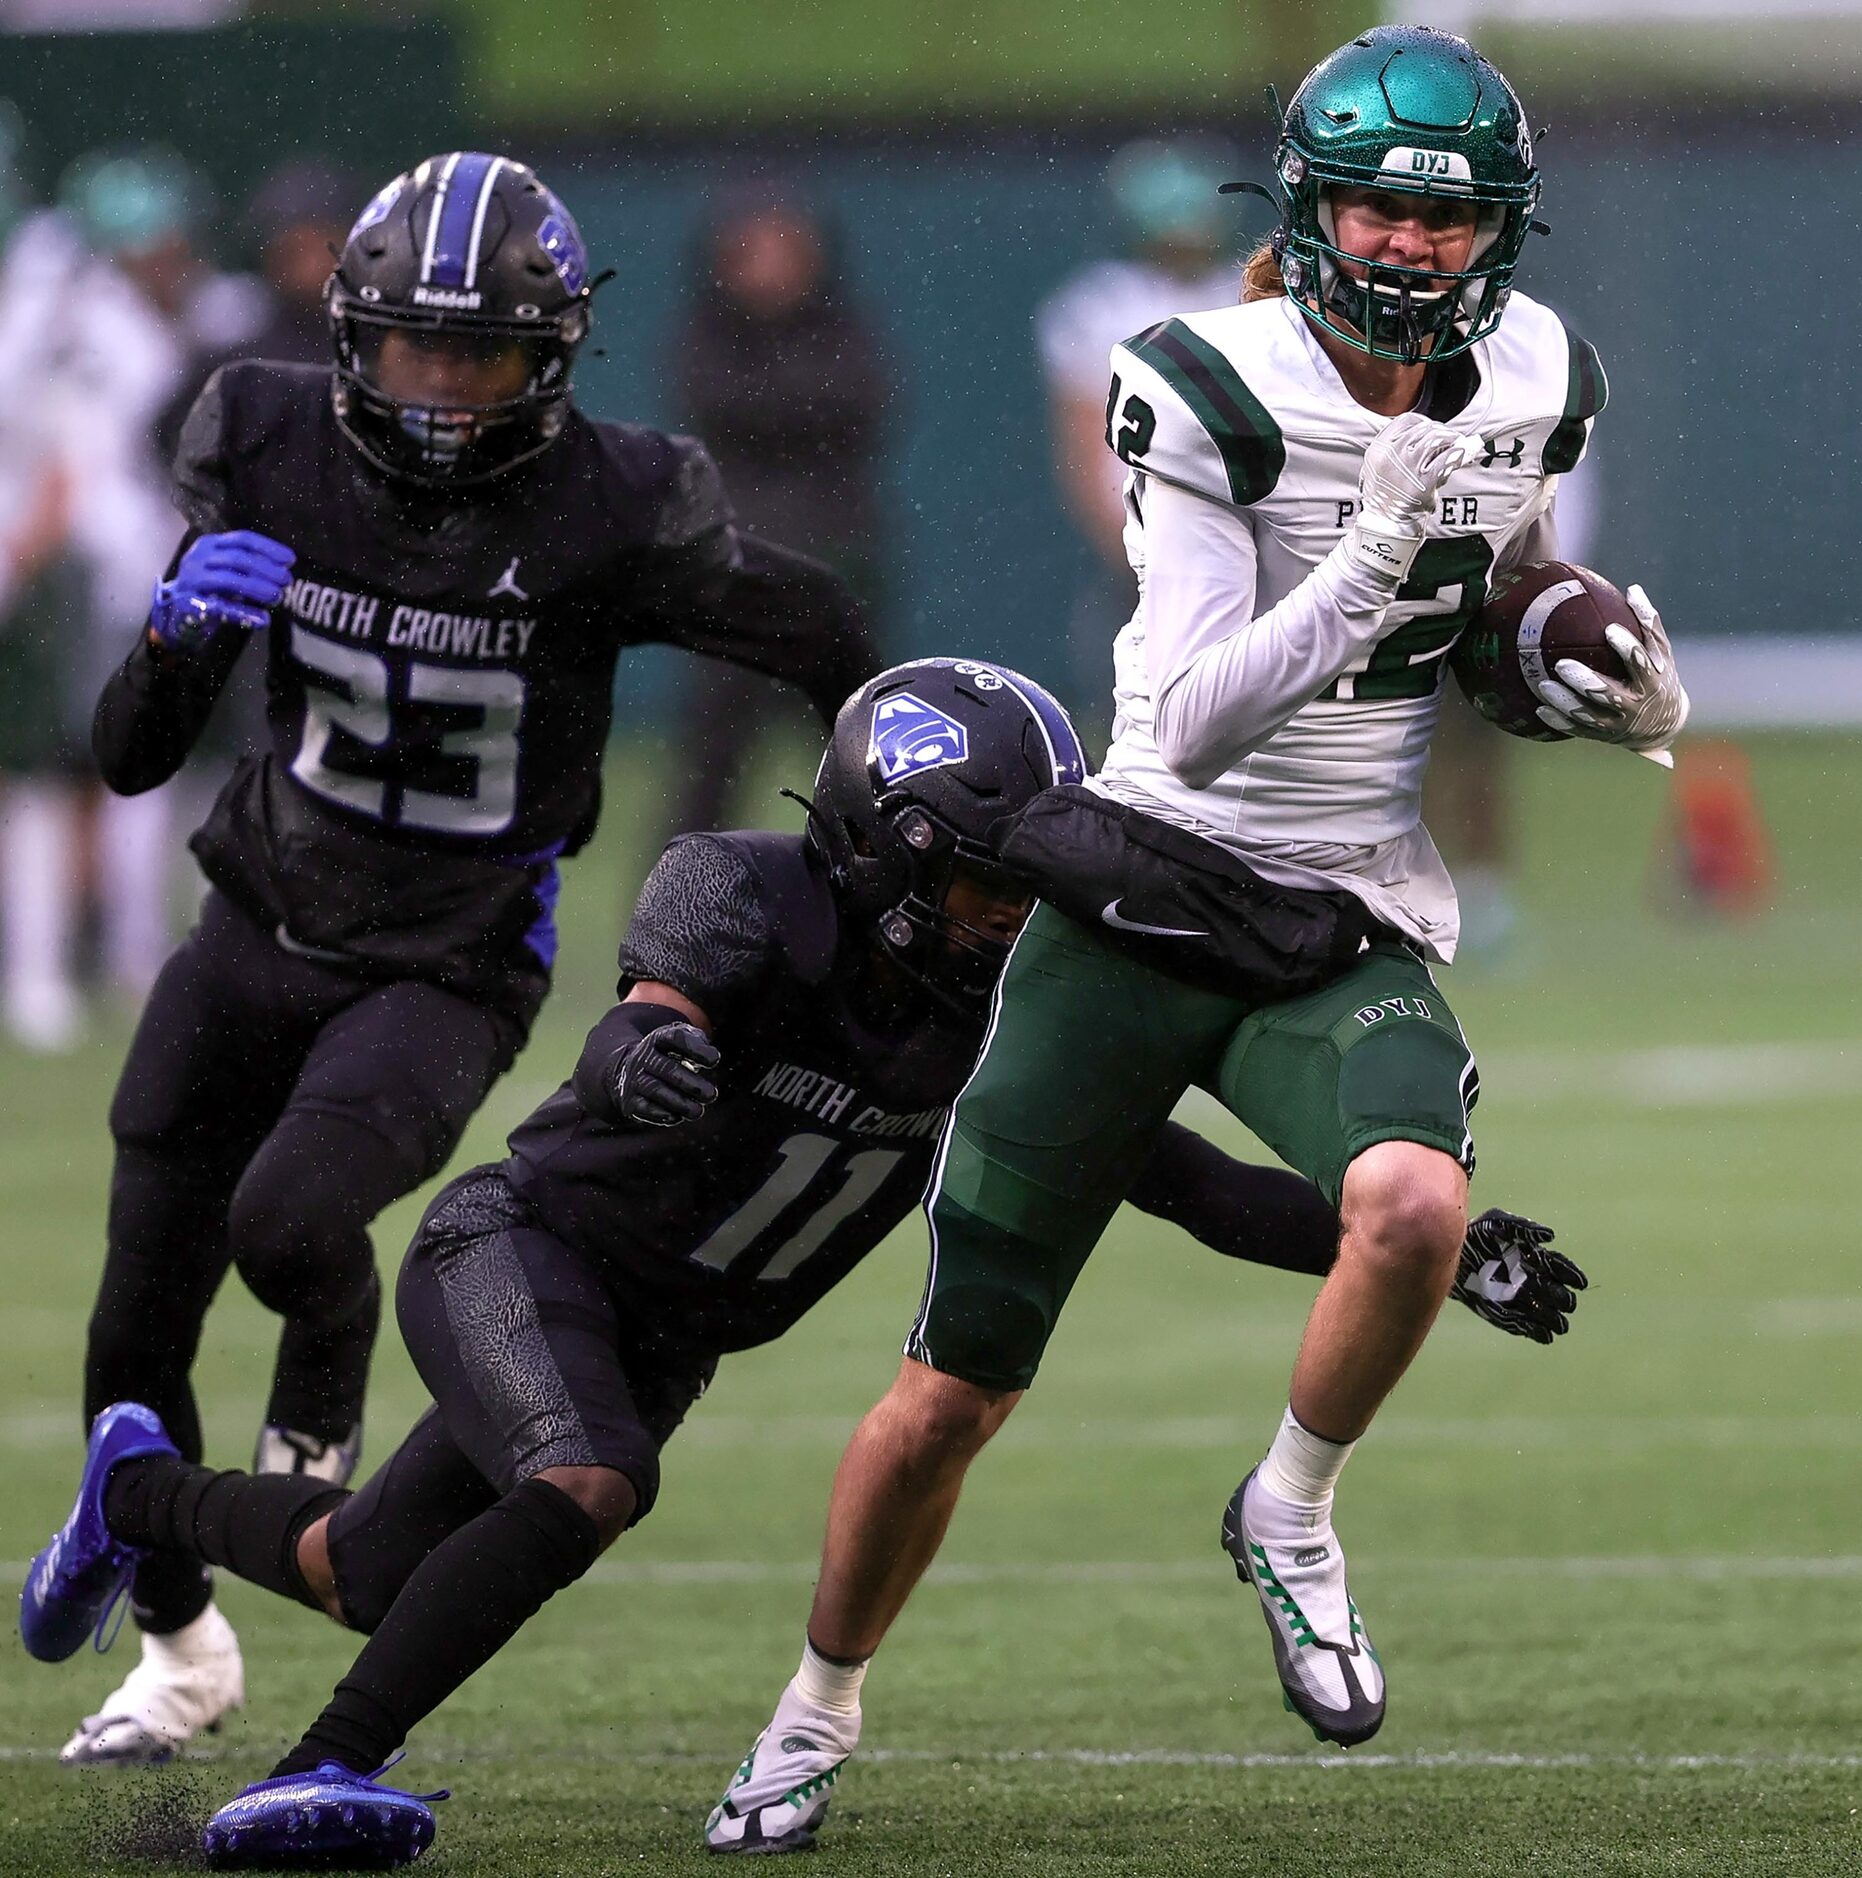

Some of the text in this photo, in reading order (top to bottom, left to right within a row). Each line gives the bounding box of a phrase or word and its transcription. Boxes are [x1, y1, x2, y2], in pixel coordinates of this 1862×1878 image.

[1411, 151, 1449, 175] DYJ
[413, 286, 481, 310] Riddell
[1105, 371, 1157, 469] 12
[283, 578, 536, 659] NORTH CROWLEY
[1314, 533, 1496, 700] 2
[290, 621, 526, 834] 23
[1353, 997, 1432, 1028] DYJ
[752, 1061, 948, 1140] NORTH CROWL
[689, 1132, 906, 1281] 11
